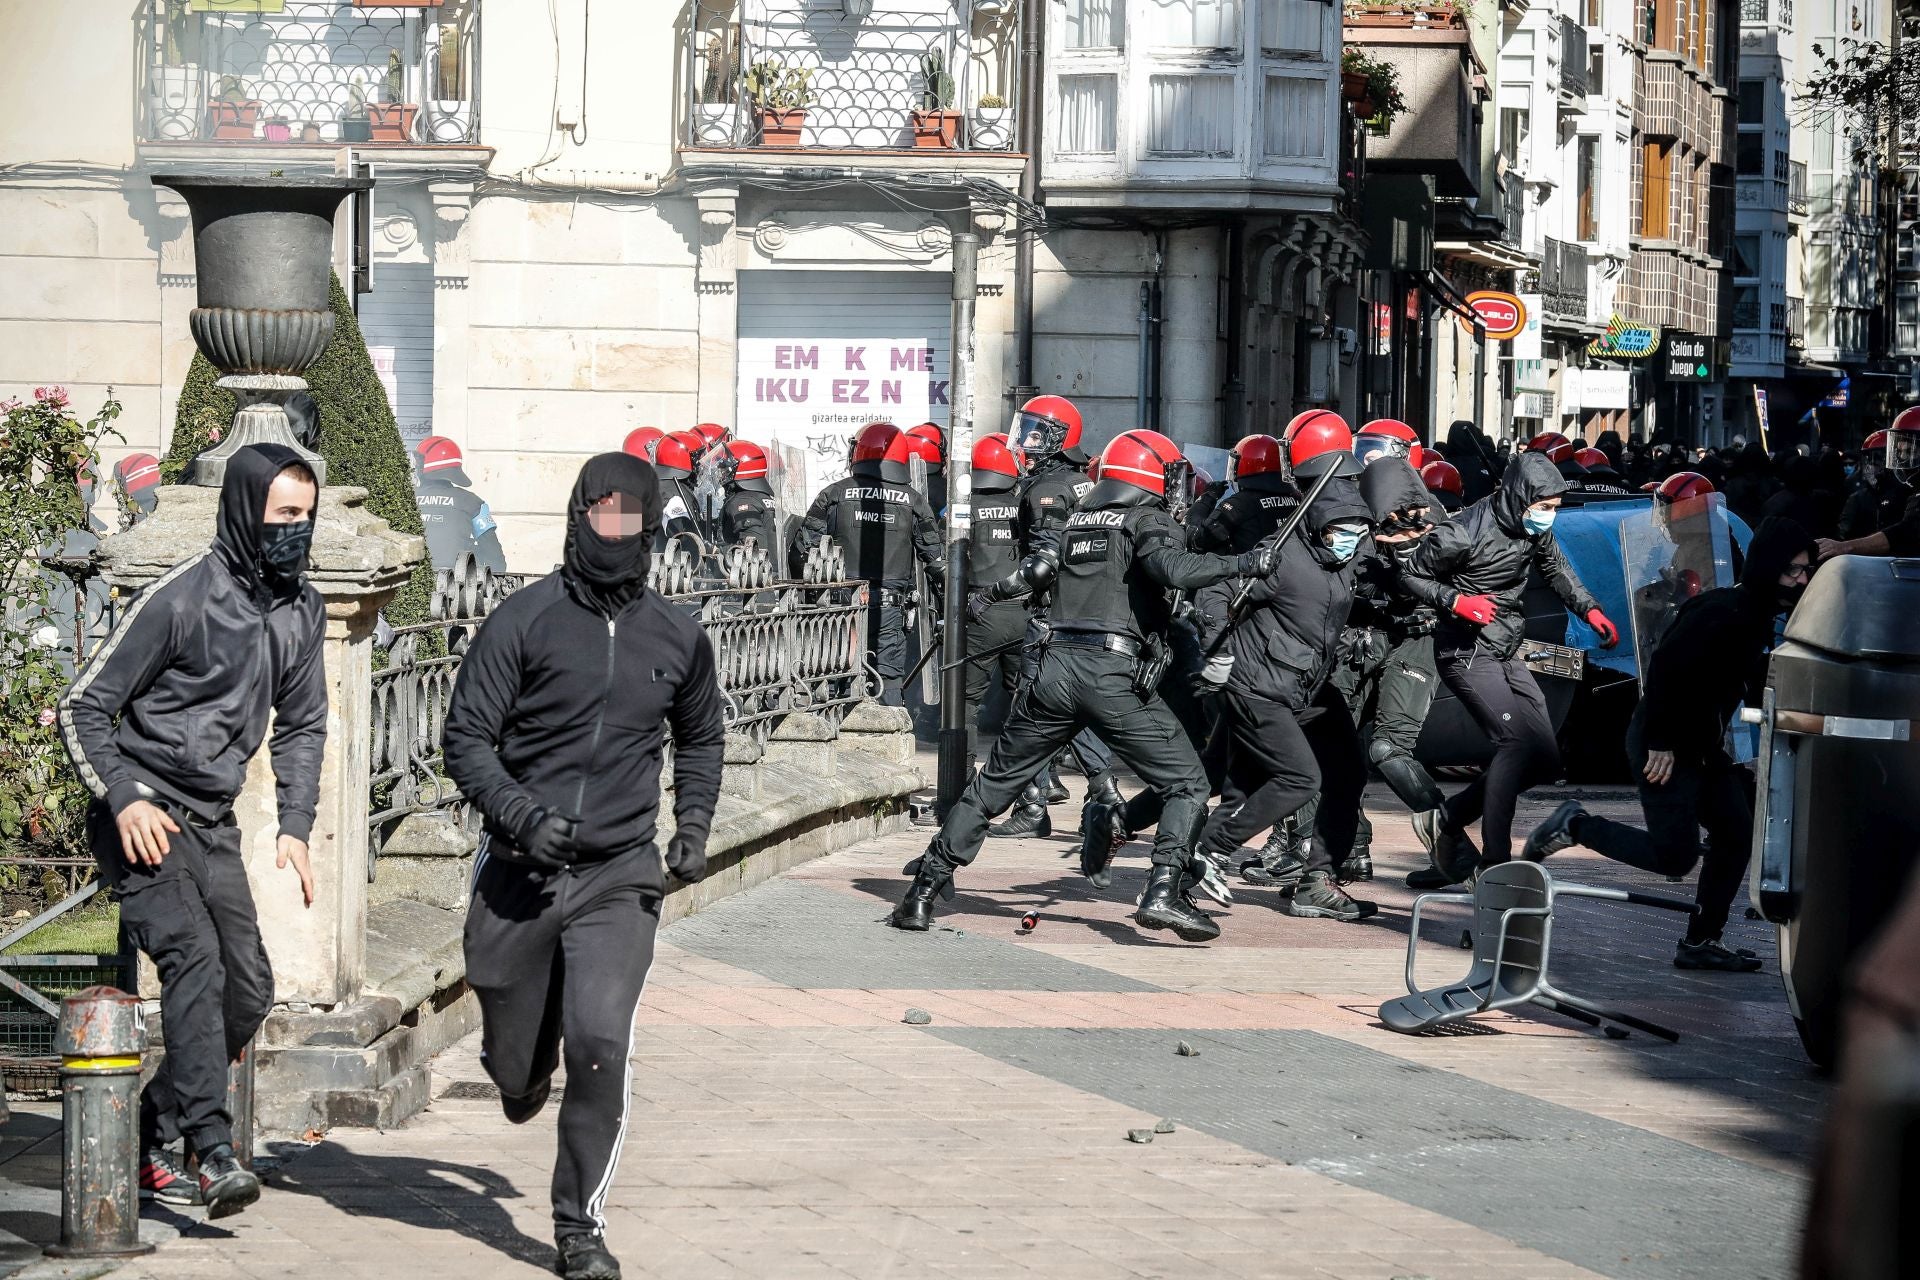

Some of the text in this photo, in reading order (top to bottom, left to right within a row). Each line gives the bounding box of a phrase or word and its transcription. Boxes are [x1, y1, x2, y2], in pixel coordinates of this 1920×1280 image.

[1618, 343, 1645, 351] FIESTAS
[1670, 341, 1704, 357] Salón de
[775, 346, 935, 372] EM K ME
[1669, 360, 1694, 377] Juego
[755, 378, 809, 403] IKU
[832, 379, 870, 404] EZ
[928, 380, 949, 405] K
[811, 412, 893, 425] gizartea eraldatuz
[845, 487, 910, 503] ERTZAINTZA
[1260, 496, 1300, 509] ERTZAINT
[855, 510, 879, 522] W4N2
[992, 528, 1012, 540] P8H3
